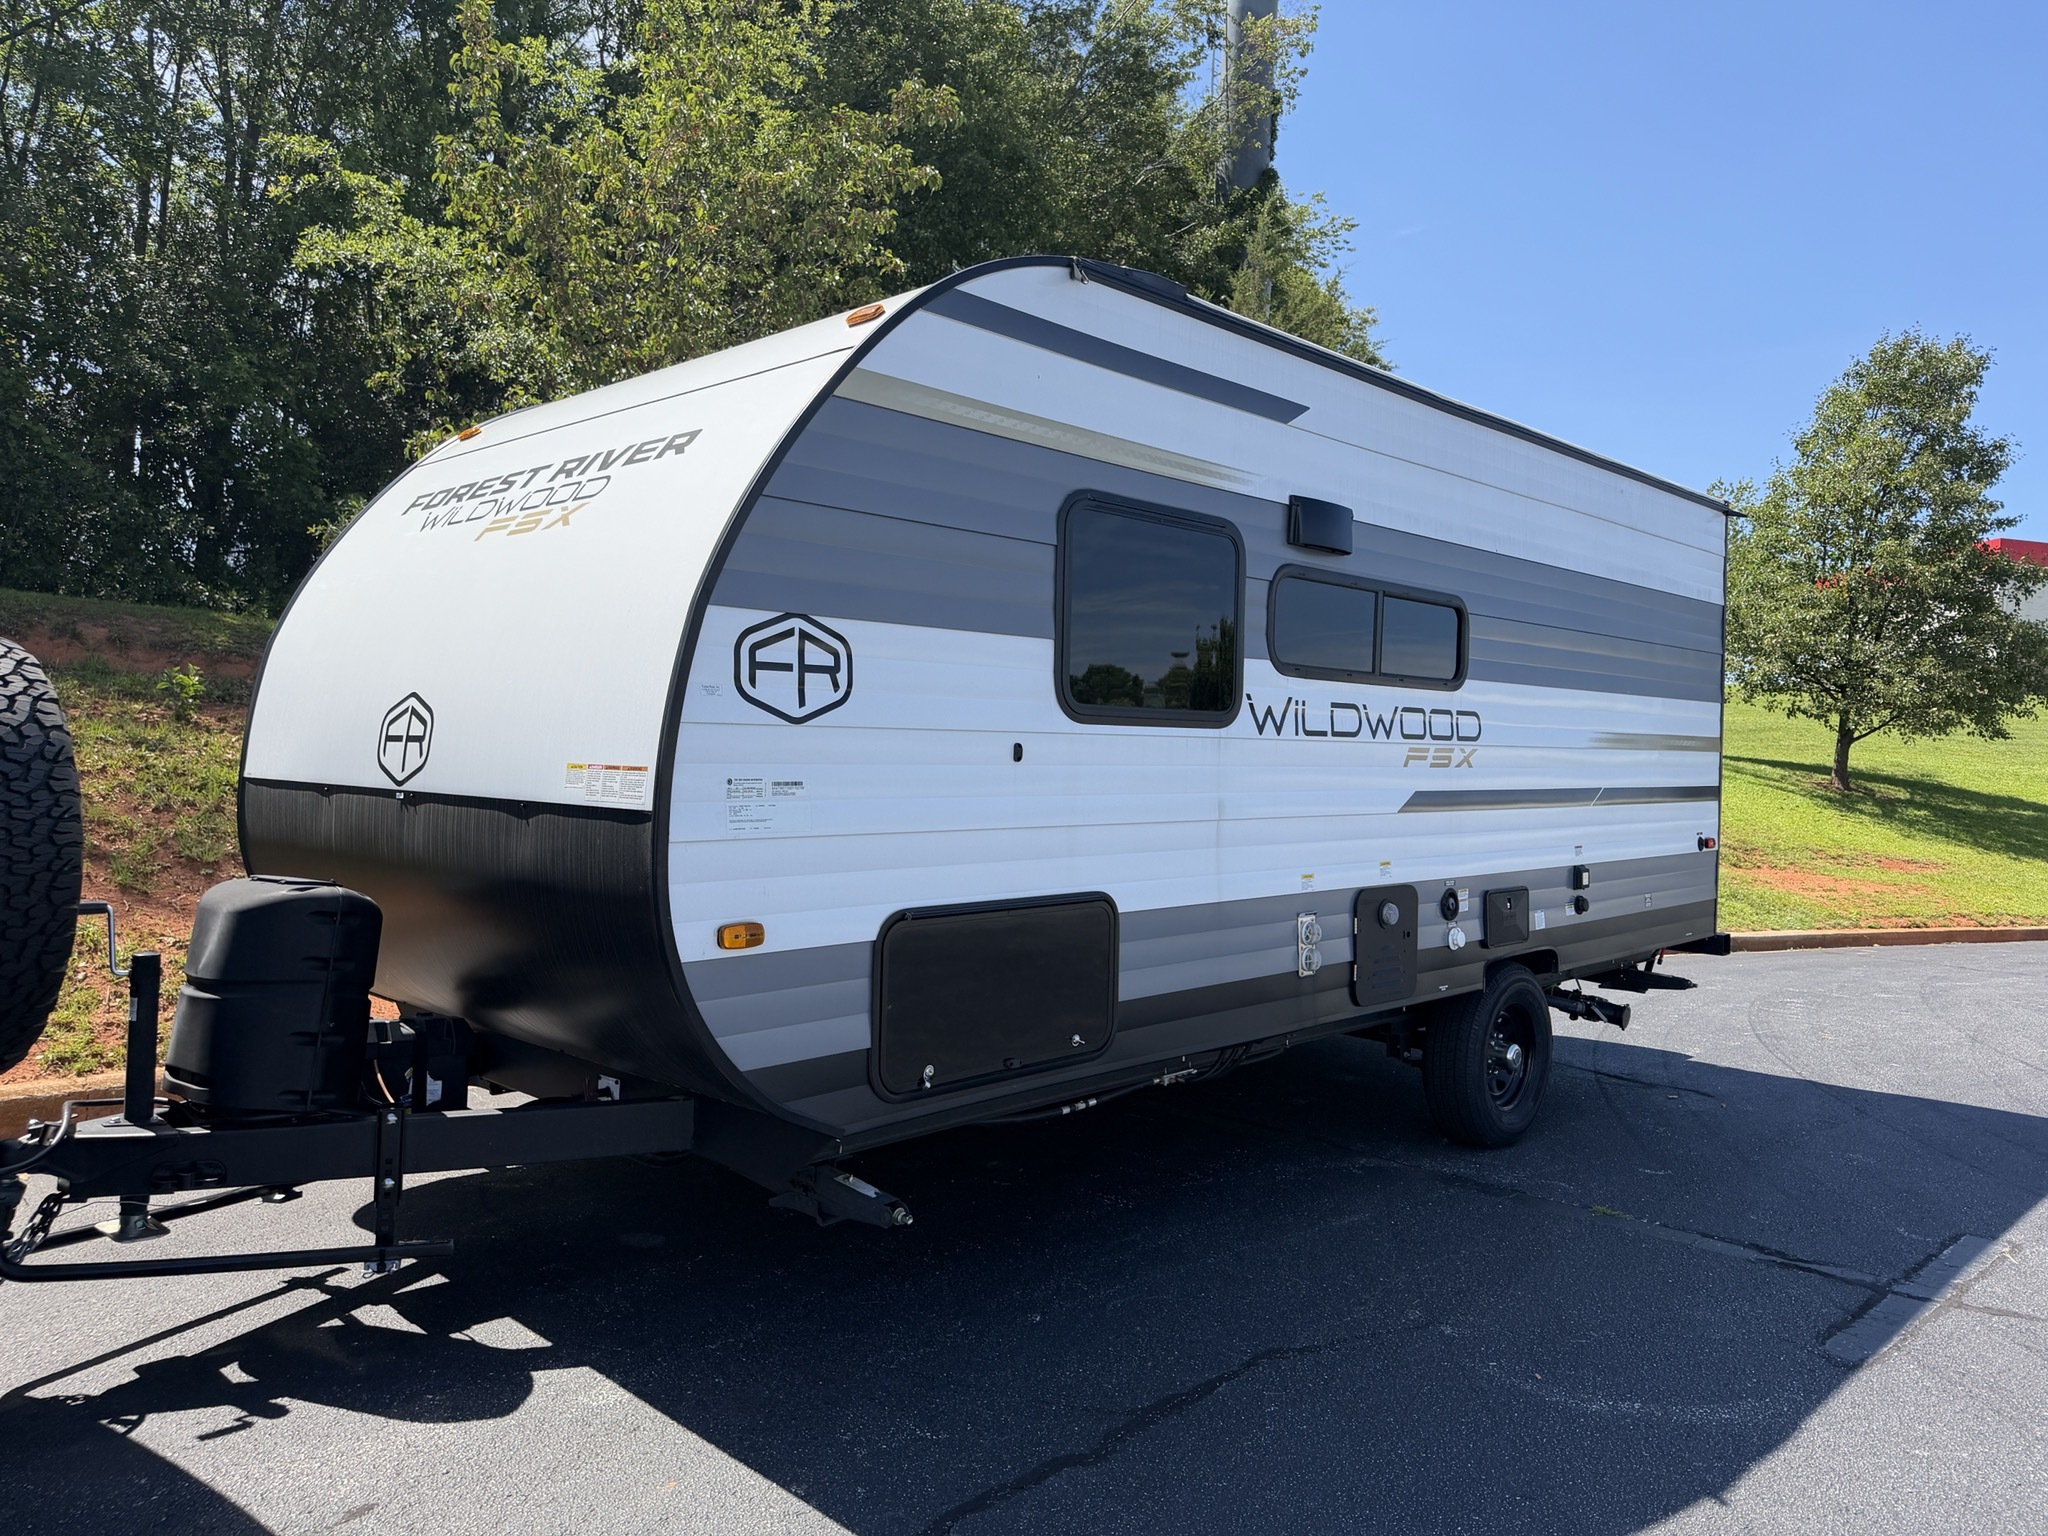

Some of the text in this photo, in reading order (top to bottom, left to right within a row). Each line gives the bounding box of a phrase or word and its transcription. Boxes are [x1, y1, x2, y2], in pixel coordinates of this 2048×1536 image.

[401, 428, 703, 516] FOREST RIVER
[420, 475, 612, 532] WILDWOOD
[474, 502, 590, 542] FSX
[1245, 693, 1482, 742] WILDWOOD
[1402, 747, 1479, 768] FSX
